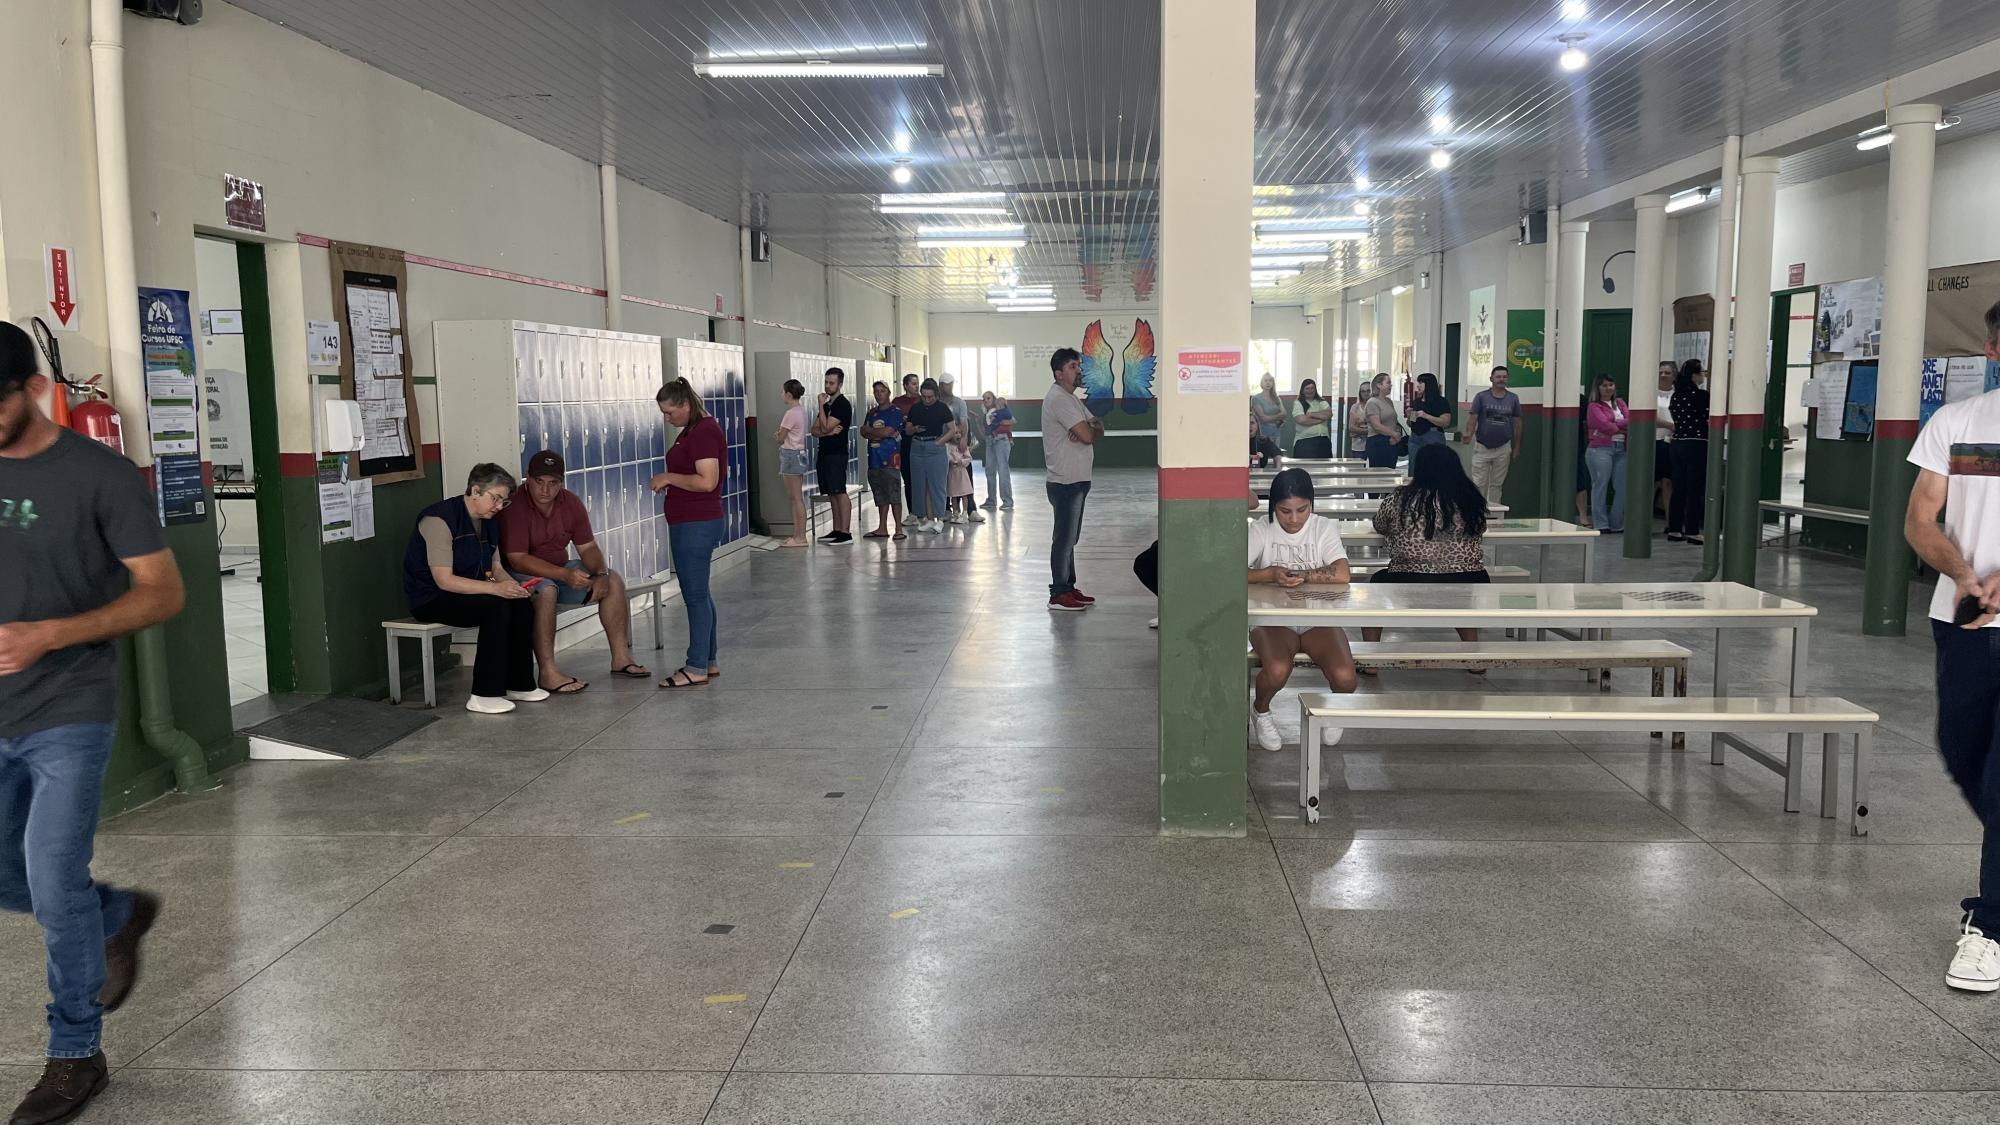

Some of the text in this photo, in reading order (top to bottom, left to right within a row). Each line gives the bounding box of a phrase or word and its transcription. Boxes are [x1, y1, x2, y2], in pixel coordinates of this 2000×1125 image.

[56, 253, 66, 316] EXTINTOR
[1938, 276, 1969, 292] CHANGES
[147, 324, 176, 334] Feira de
[141, 334, 184, 344] Cursos UFSC
[323, 336, 338, 349] 143
[1522, 357, 1545, 373] Apr
[1922, 358, 1938, 374] ORE
[1921, 373, 1944, 389] ANET
